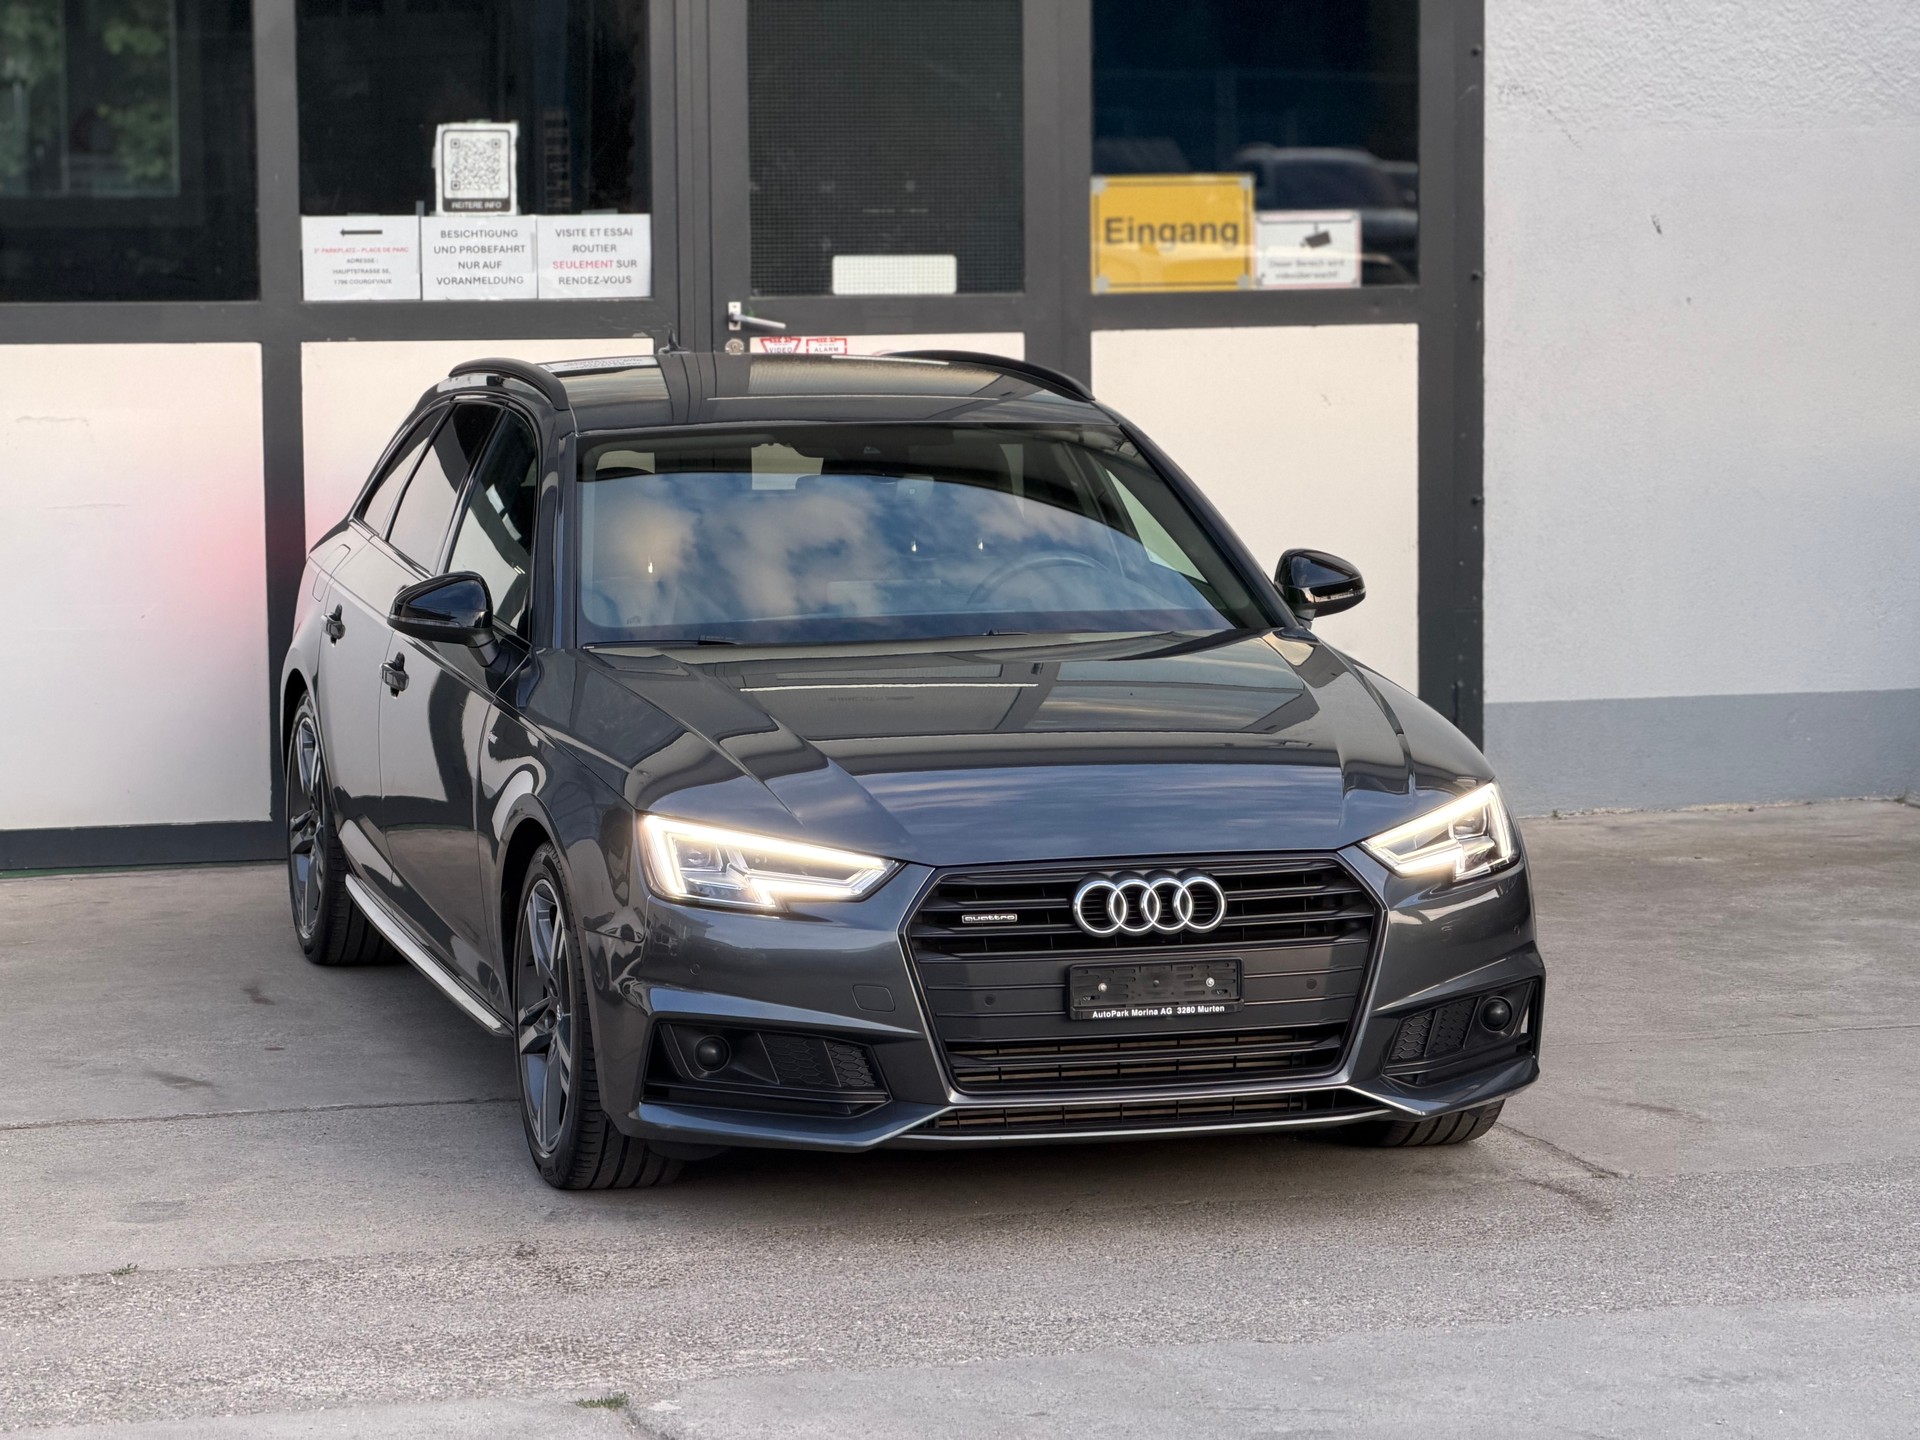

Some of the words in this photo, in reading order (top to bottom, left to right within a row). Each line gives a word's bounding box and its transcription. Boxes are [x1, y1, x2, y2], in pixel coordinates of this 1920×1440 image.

[485, 201, 502, 209] INFO
[440, 229, 518, 239] BESICHTIGUNG
[555, 228, 587, 238] VISITE
[589, 228, 601, 238] ET
[603, 227, 633, 237] ESSAI
[1104, 216, 1239, 251] Eingang
[433, 245, 456, 254] UND
[459, 244, 526, 254] PROBEFAHRT
[572, 244, 617, 253] ROUTIER
[457, 261, 480, 270] NUR
[482, 260, 503, 269] AUF
[552, 260, 614, 270] SEULEMENT
[616, 259, 638, 269] SUR
[436, 276, 524, 286] VORANMELDUNG
[558, 275, 632, 285] RENDEZ-VOUS
[964, 914, 1015, 922] quattro
[1092, 1008, 1129, 1019] AutoPark
[1131, 1008, 1158, 1017] Morina
[1160, 1007, 1173, 1016] AG
[1177, 1006, 1196, 1015] 3280
[1197, 1005, 1225, 1014] Murten
